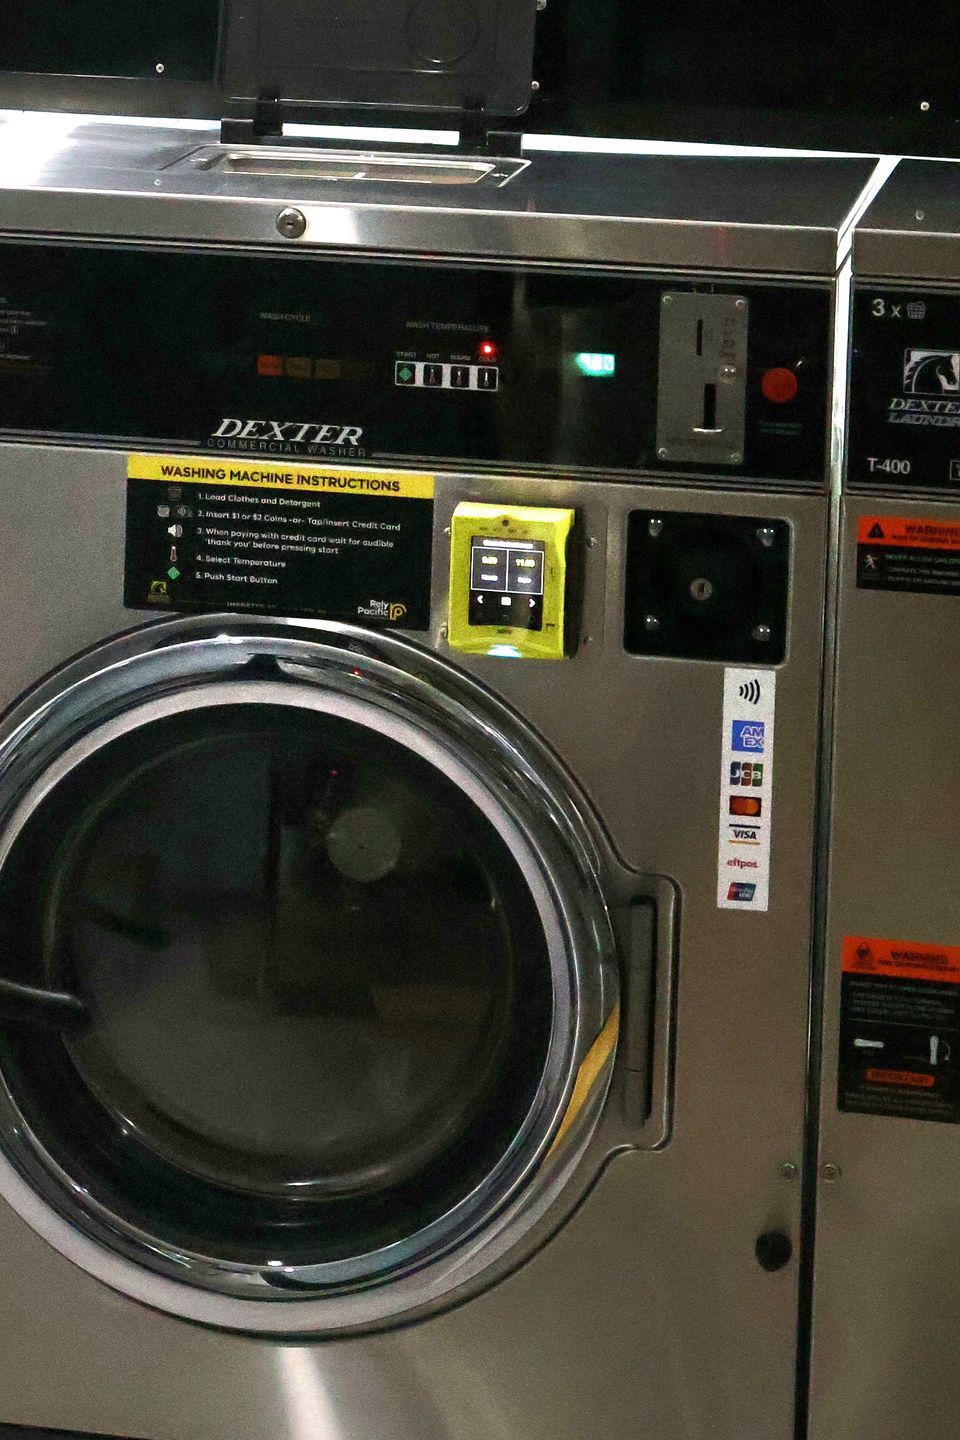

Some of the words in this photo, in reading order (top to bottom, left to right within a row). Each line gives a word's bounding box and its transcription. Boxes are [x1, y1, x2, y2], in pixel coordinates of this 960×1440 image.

[211, 418, 363, 446] DEXTER
[207, 438, 298, 453] COMMERCIAL
[308, 444, 366, 457] WASHER
[867, 458, 910, 474] T-400
[161, 465, 226, 480] WASHING
[230, 470, 293, 484] MACHINE
[297, 474, 400, 491] INSTRUCTIONS
[205, 493, 226, 501] Load
[228, 495, 259, 503] Clothes
[261, 497, 277, 505] and
[279, 498, 320, 508] Detergent
[206, 511, 229, 519] Insert
[264, 514, 287, 523] Coins
[352, 521, 378, 529] Credit
[380, 523, 400, 531] Card
[206, 528, 228, 536] When
[231, 530, 259, 540] paying
[261, 532, 278, 540] with
[281, 533, 305, 542] credit
[307, 535, 326, 543] card
[329, 536, 346, 544] wait
[363, 540, 394, 548] audible
[253, 541, 279, 550] before
[282, 544, 316, 554] pressing
[318, 546, 338, 554] start
[206, 555, 230, 564] Select
[234, 557, 286, 568] Temperature
[204, 572, 224, 580] Push
[226, 574, 247, 582] Start
[250, 576, 278, 584] Button
[733, 829, 757, 840] VISA
